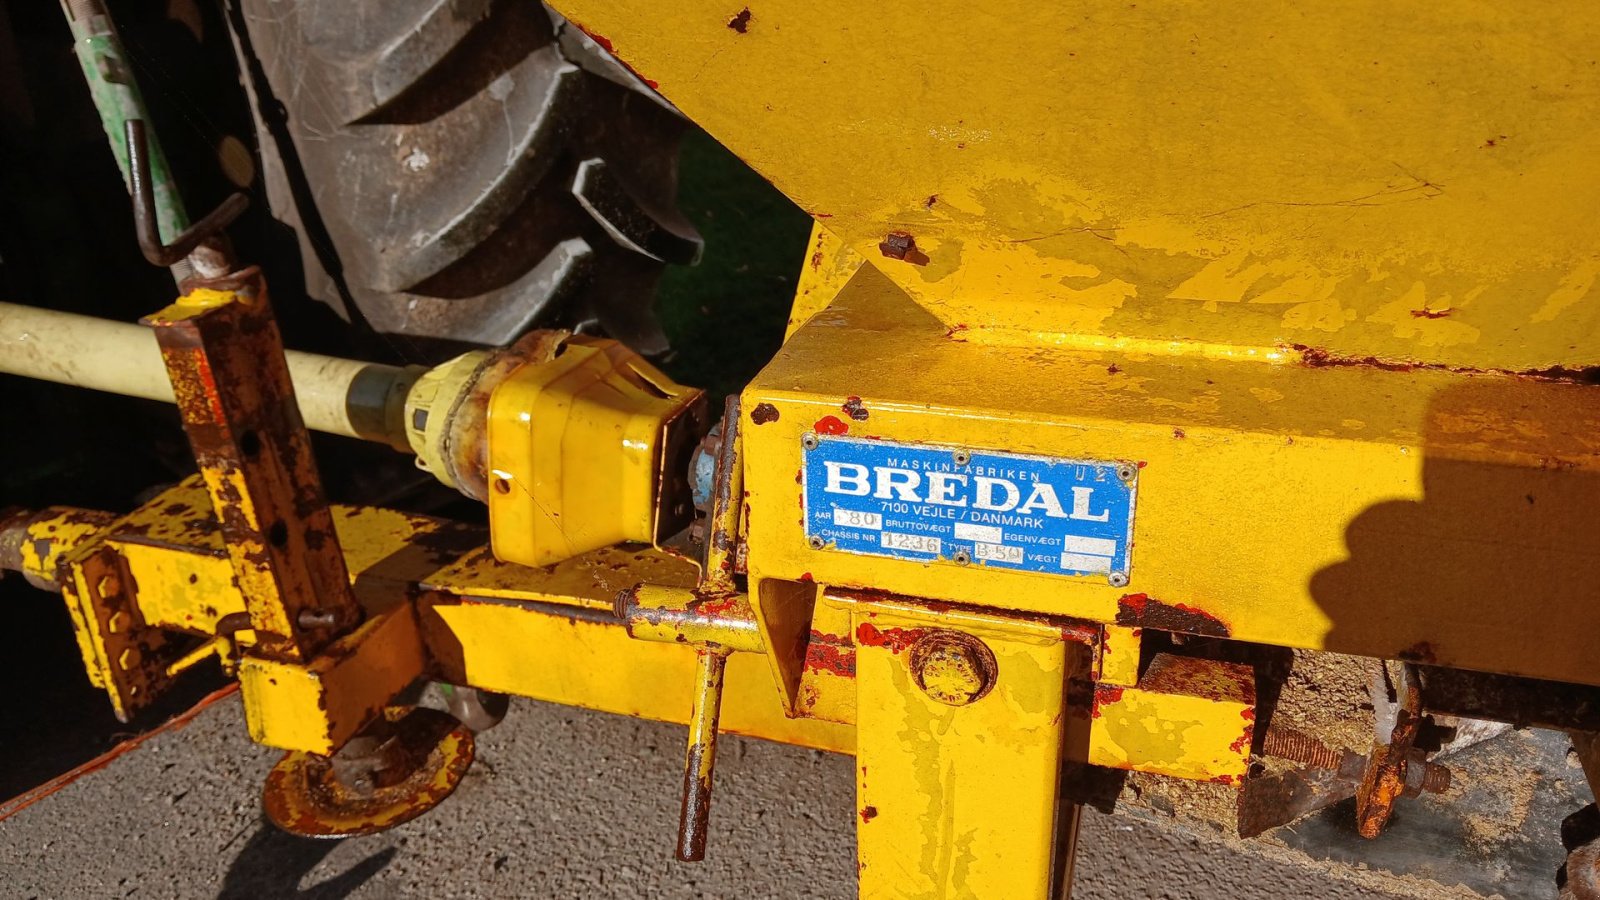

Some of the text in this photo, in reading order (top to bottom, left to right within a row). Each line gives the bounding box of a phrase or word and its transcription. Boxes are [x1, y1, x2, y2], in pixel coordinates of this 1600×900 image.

[823, 460, 1110, 522] BREDAL
[814, 511, 832, 520] AAR
[912, 505, 956, 519] VEJLE
[971, 511, 1043, 529] DANMARK
[885, 519, 952, 533] BRUTTOVÆGT
[821, 528, 860, 540] CHASSIS
[1004, 533, 1062, 547] EGENVÆGT
[948, 543, 972, 553] TYPE
[1027, 553, 1058, 563] VÆGT
